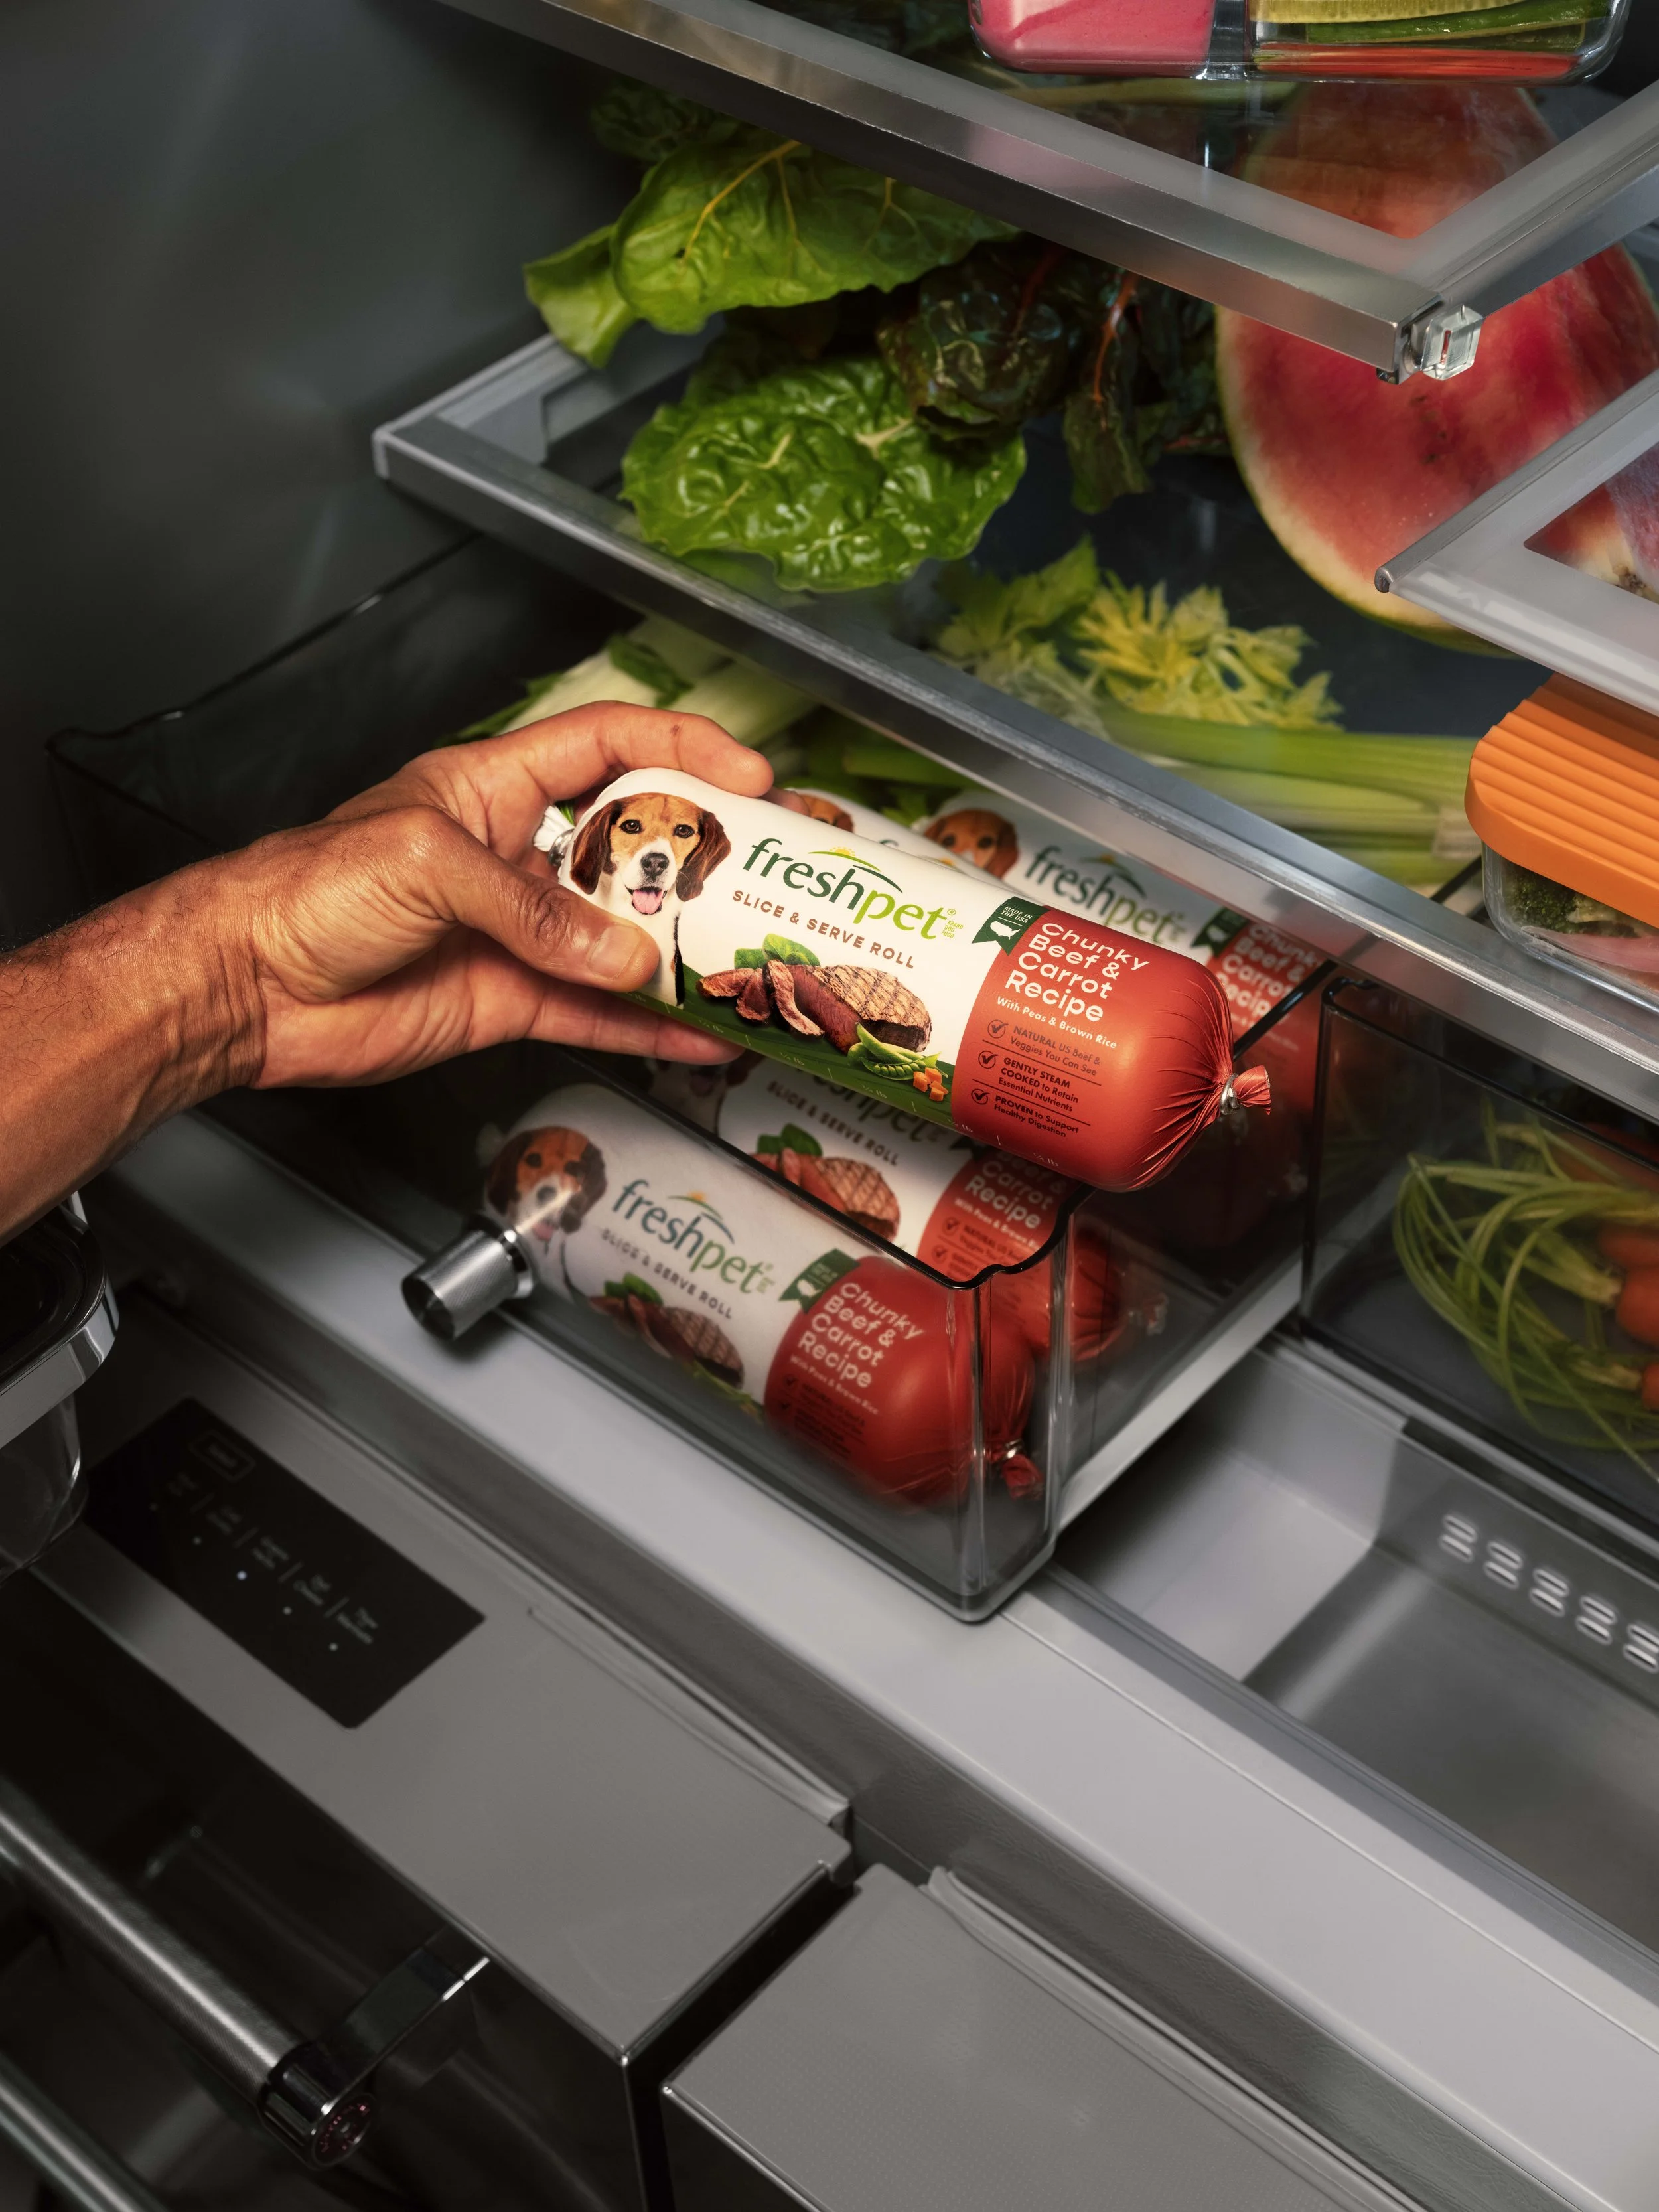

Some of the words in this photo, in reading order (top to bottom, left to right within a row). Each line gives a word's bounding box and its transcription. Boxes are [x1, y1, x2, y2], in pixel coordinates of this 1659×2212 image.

[732, 890, 784, 918] SLICE
[789, 912, 800, 924] &
[806, 918, 865, 949] SERVE
[869, 942, 914, 969] ROLL
[941, 930, 954, 938] FOOD
[947, 920, 964, 930] BRAND
[1001, 909, 1015, 919] THE
[1015, 915, 1029, 923] USA
[1003, 906, 1024, 916] MADE
[1028, 934, 1100, 969] Beef
[1102, 962, 1120, 980] &
[1041, 923, 1150, 971] Chunky
[1005, 969, 1104, 1022] Recipe
[1018, 952, 1113, 999] Carrot
[997, 996, 1020, 1013] With
[1022, 1006, 1046, 1022] Peas
[1048, 1017, 1056, 1027] &
[1059, 1021, 1093, 1040] Brown
[1095, 1034, 1117, 1049] Rice
[1013, 1025, 1056, 1049] NATURAL
[1059, 1043, 1070, 1054] US
[1072, 1049, 1096, 1065] Beef
[1093, 1057, 1101, 1066] &
[1003, 1057, 1038, 1075] GENTLY
[1039, 1071, 1070, 1088] STEAM
[1011, 1036, 1043, 1056] Veggies
[1045, 1049, 1060, 1062] You
[1062, 1057, 1079, 1069] Can
[1081, 1065, 1097, 1076] See
[998, 1076, 1034, 1096] Essential
[1035, 1092, 1073, 1112] Nutrients
[1001, 1067, 1040, 1088] COOKED
[1042, 1084, 1050, 1092] to
[1052, 1087, 1078, 1103] Retain
[994, 1104, 1026, 1122] Healthy
[1028, 1117, 1066, 1138] Digestion
[995, 1095, 1033, 1116] PROVEN
[1035, 1110, 1043, 1120] to
[1045, 1115, 1079, 1134] Support
[865, 1139, 900, 1166] ROLL
[965, 1174, 1041, 1229] Recipe
[982, 1160, 1054, 1210] Carrot
[612, 1179, 764, 1294] freshpet
[654, 1262, 697, 1296] SERVE
[698, 1290, 733, 1319] ROLL
[840, 1282, 926, 1341] Chunky
[811, 1312, 885, 1367] Carrot
[824, 1295, 882, 1335] Beef
[877, 1328, 897, 1348] &
[798, 1330, 872, 1388] Recipe
